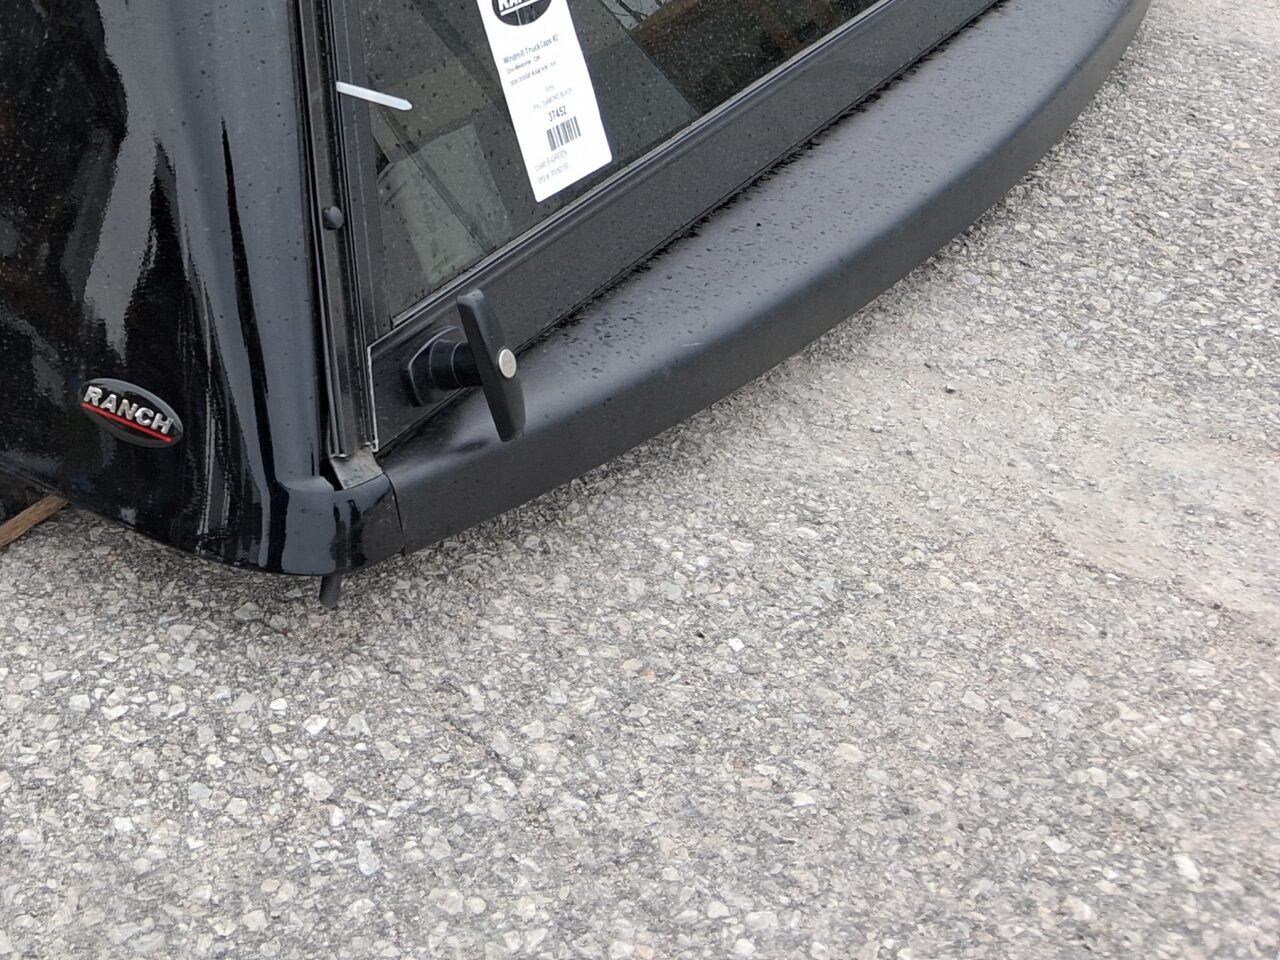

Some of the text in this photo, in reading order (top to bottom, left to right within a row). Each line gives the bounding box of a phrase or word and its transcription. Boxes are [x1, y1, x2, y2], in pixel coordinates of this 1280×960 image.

[524, 41, 541, 54] Truck
[548, 105, 568, 123] 37452
[83, 385, 174, 435] RANCH
